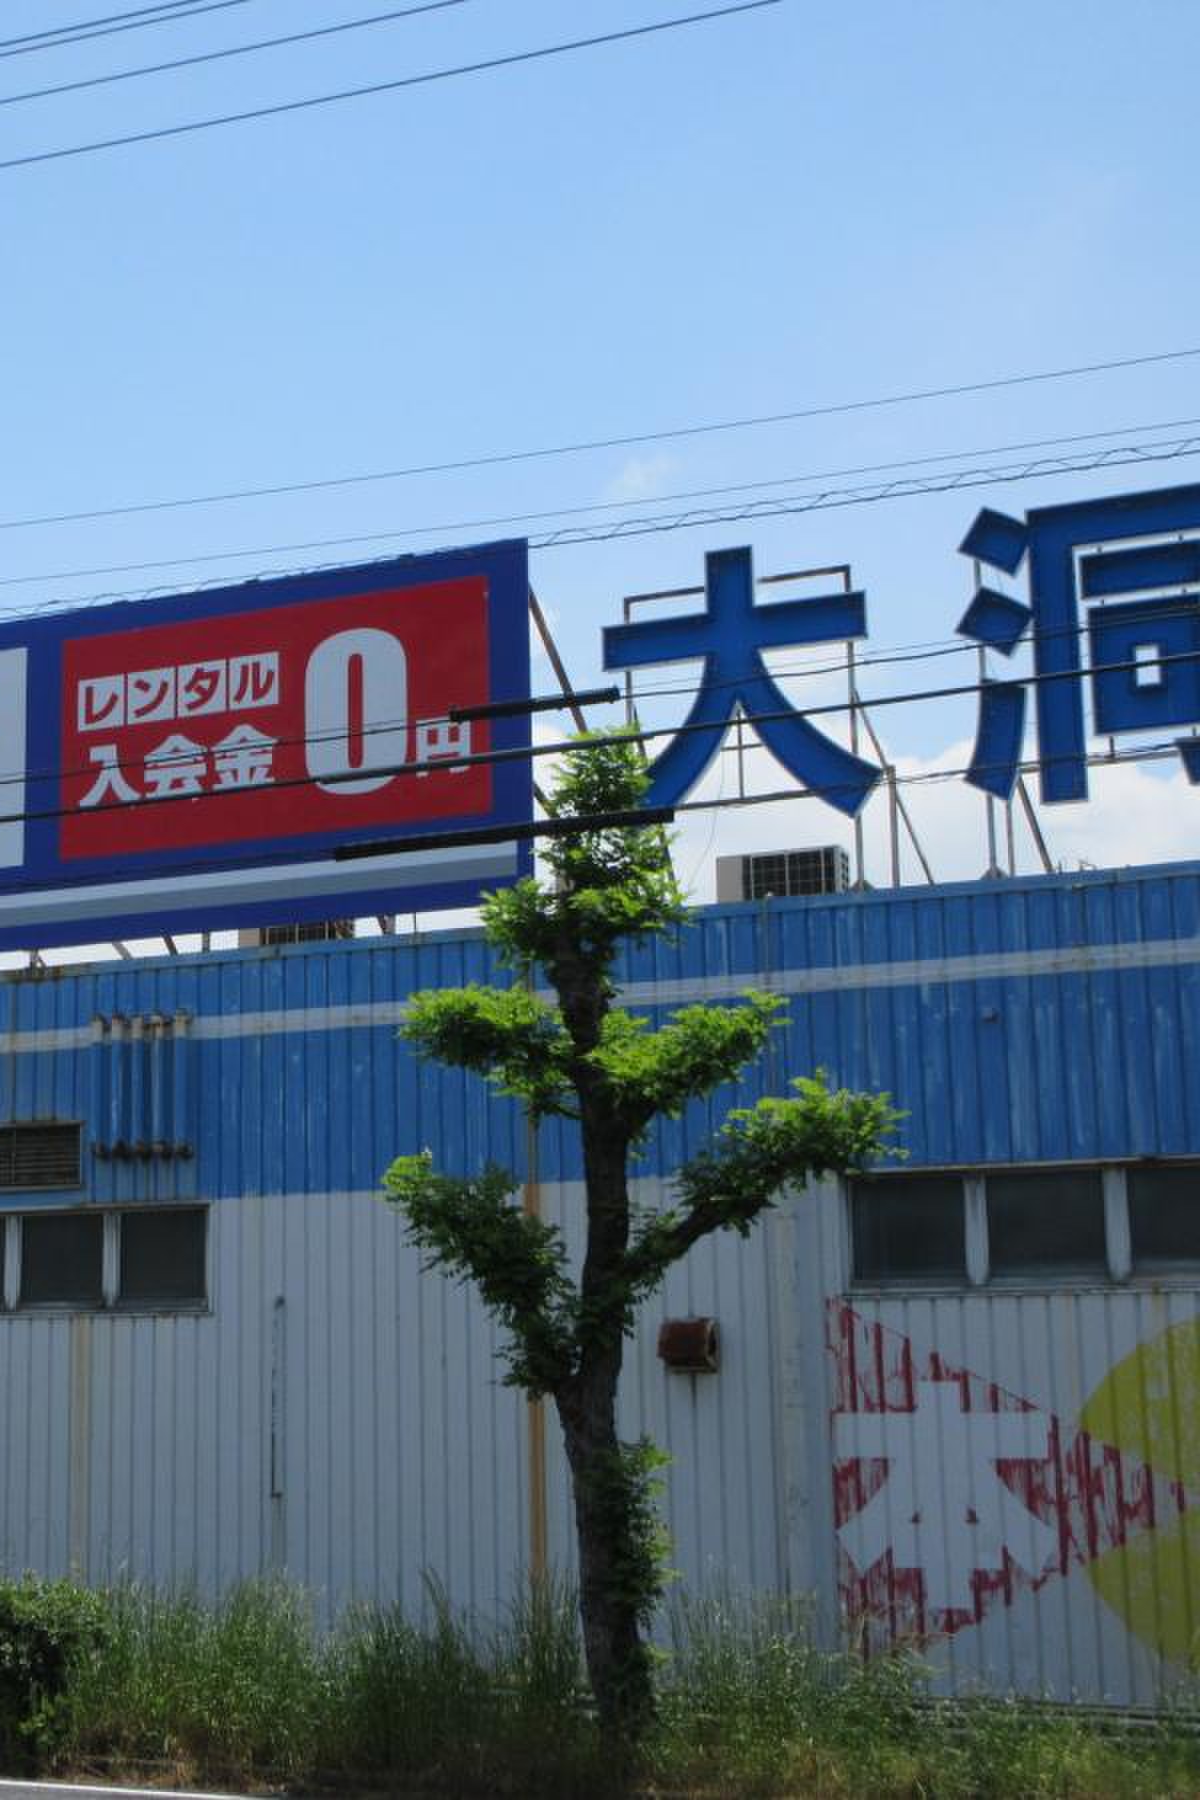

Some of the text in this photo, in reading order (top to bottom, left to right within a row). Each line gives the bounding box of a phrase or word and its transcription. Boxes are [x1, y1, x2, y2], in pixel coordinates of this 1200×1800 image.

[83, 660, 277, 726] レンタル
[79, 724, 278, 809] 入会金
